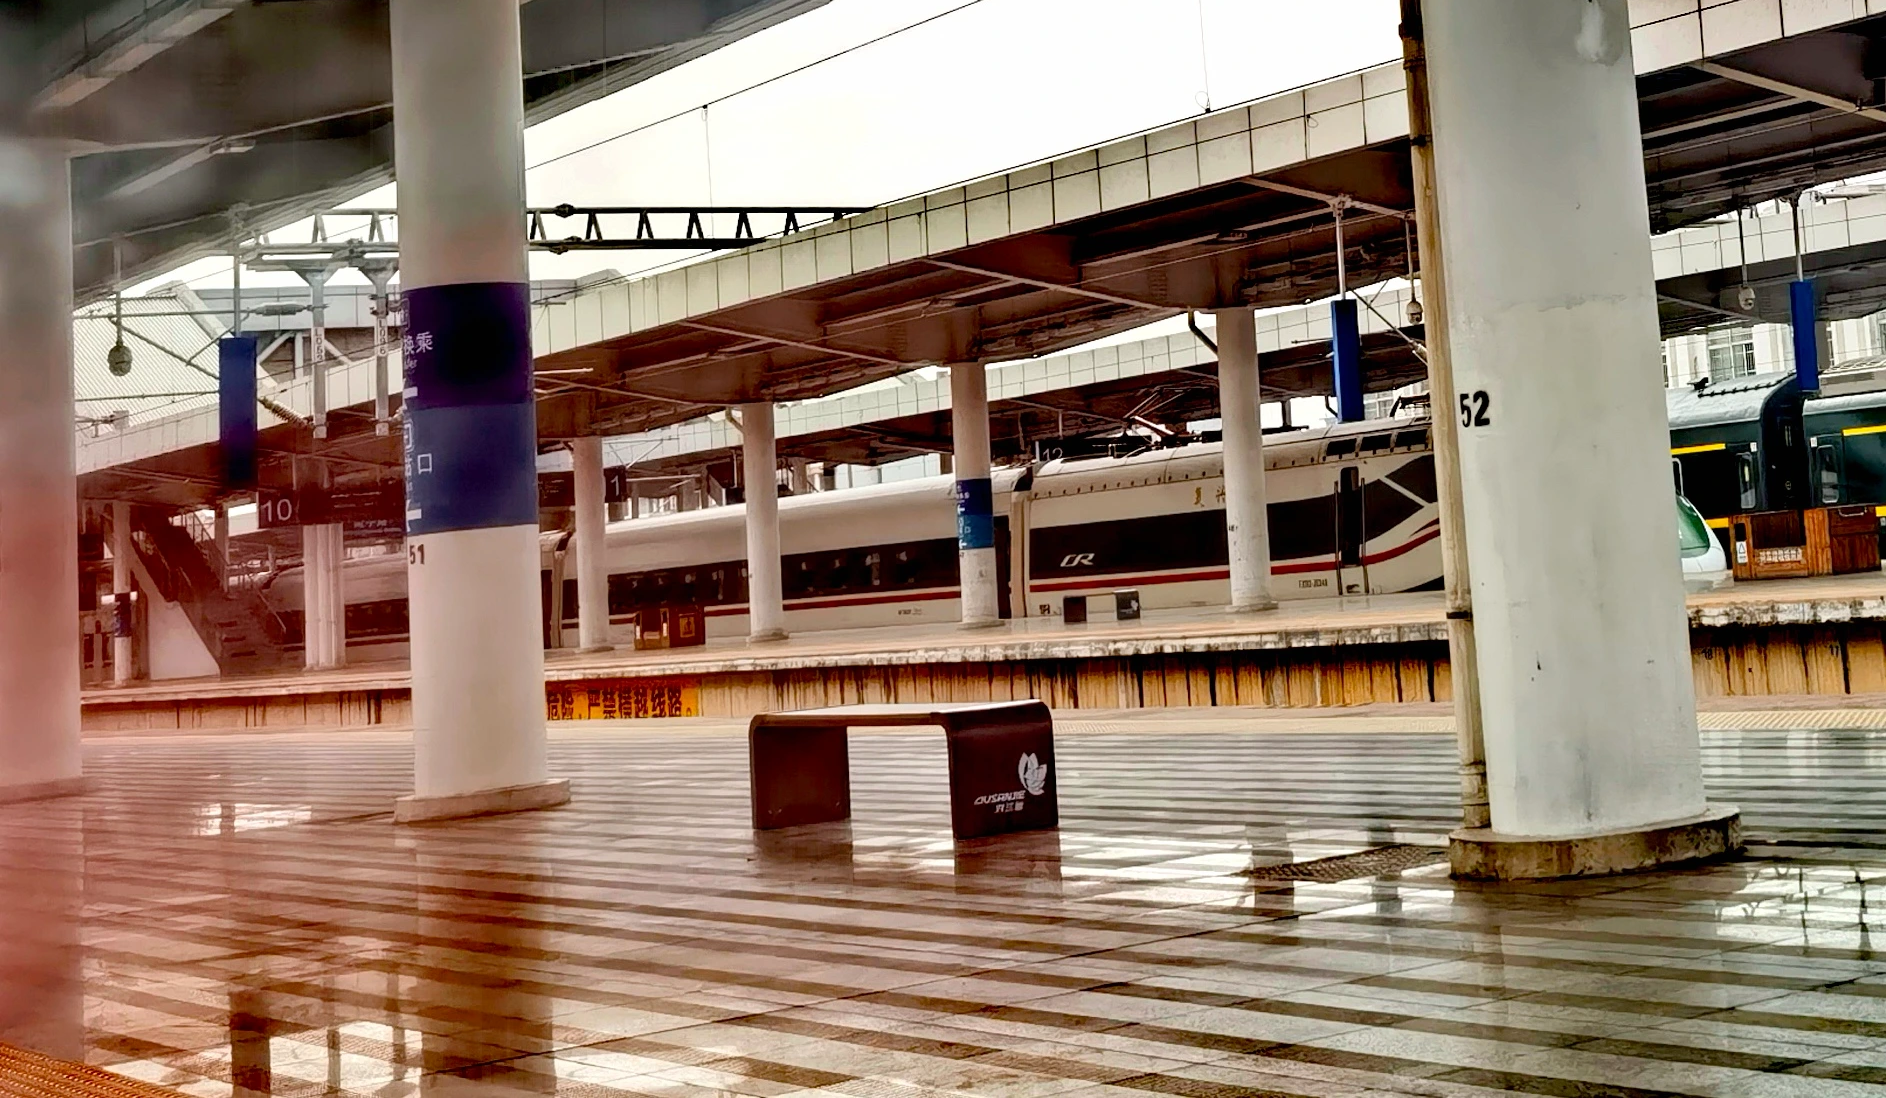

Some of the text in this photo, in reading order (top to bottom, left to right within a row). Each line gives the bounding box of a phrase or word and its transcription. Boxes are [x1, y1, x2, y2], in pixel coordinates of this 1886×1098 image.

[1459, 390, 1491, 428] 52
[260, 498, 293, 522] 10
[409, 544, 425, 565] 51
